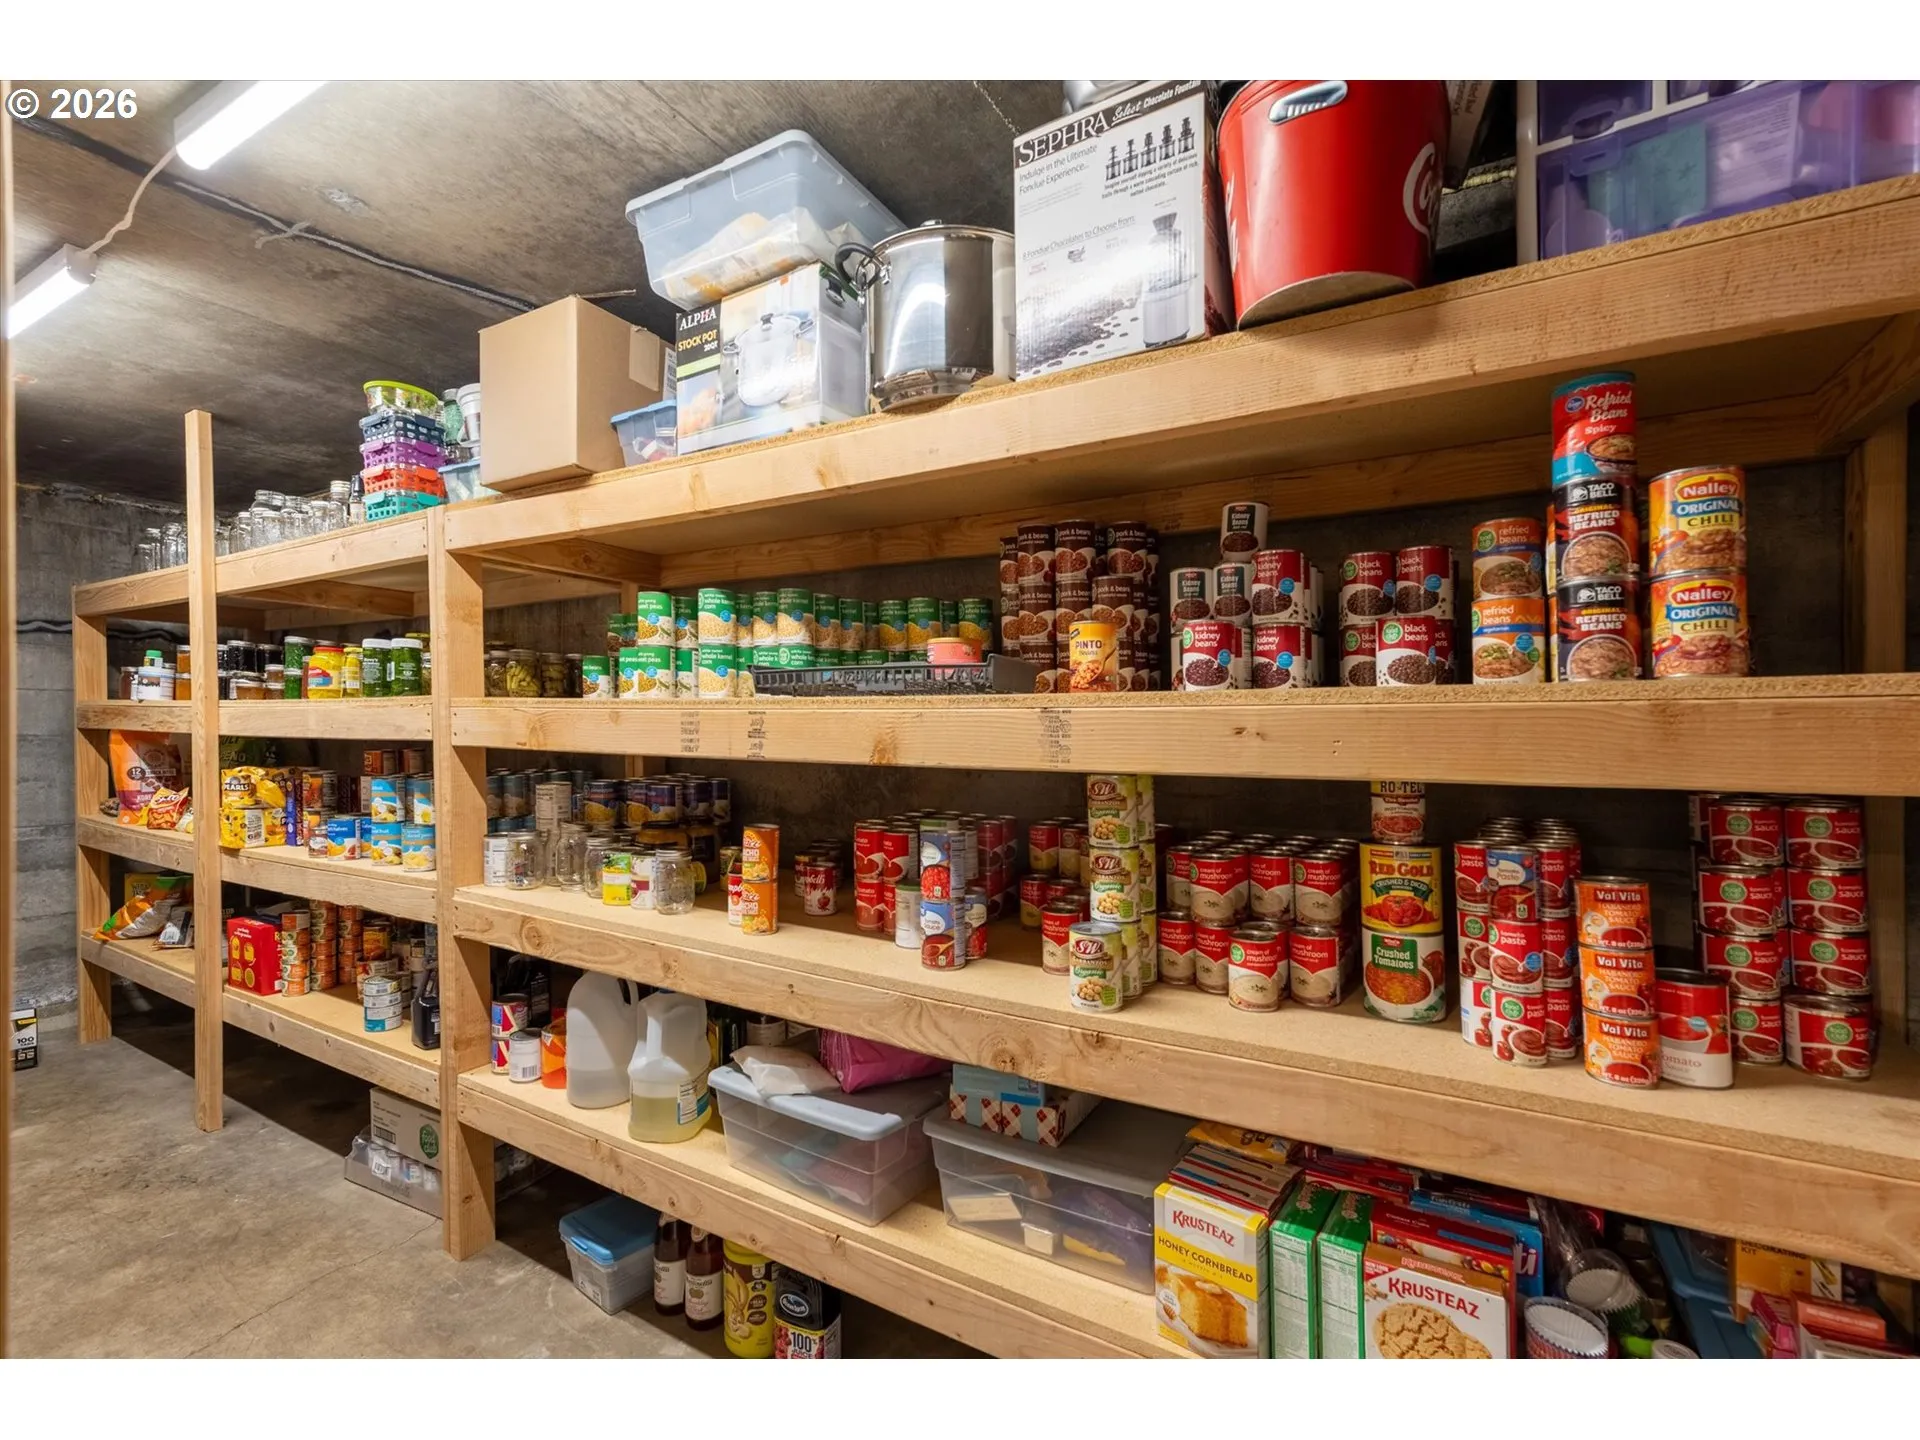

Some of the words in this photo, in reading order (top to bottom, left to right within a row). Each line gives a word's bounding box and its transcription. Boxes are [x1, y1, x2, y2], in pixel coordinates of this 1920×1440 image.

[1019, 111, 1110, 166] SEPHRA
[1112, 102, 1143, 122] Select
[1143, 89, 1174, 109] Chocolate
[1174, 80, 1201, 95] Fountain
[1019, 166, 1046, 182] Indulge
[1046, 165, 1053, 173] in
[1053, 158, 1066, 170] the
[1066, 145, 1098, 164] Ultimate
[1018, 180, 1045, 195] Fondue
[1092, 222, 1118, 234] Choose
[679, 307, 717, 331] ALPHA
[678, 334, 702, 352] STOCK
[702, 328, 717, 343] POT
[1585, 391, 1632, 410] Refried
[1591, 407, 1628, 423] Beans
[1585, 424, 1617, 434] Spicy
[1588, 482, 1615, 492] TACO
[1682, 482, 1737, 498] Nalley
[1588, 490, 1616, 499] BELL
[1676, 499, 1739, 515] ORIGINAL
[1231, 513, 1251, 521] Kidney
[1568, 510, 1620, 524] REFRIED
[1687, 514, 1735, 527] CHILI
[1575, 518, 1616, 530] BEANS
[1075, 528, 1092, 536] beans
[1499, 525, 1530, 535] refried
[1500, 535, 1528, 545] beans
[1360, 560, 1382, 569] black
[1360, 568, 1383, 577] beans
[1220, 576, 1239, 584] Kidney
[1114, 584, 1131, 593] beans
[1183, 585, 1200, 593] Beans
[1221, 582, 1238, 590] Beans
[1595, 586, 1622, 594] TACO
[1597, 592, 1624, 601] BELL
[1675, 587, 1731, 602] Nalley
[1483, 605, 1514, 615] refried
[1671, 605, 1736, 620] ORIGINAL
[1483, 615, 1512, 625] beans
[1576, 613, 1627, 624] REFRIED
[1404, 624, 1428, 633] black
[1580, 622, 1623, 631] BEANS
[1681, 621, 1729, 632] CHILI
[1194, 631, 1220, 641] kidney
[1256, 635, 1280, 645] kidney
[1404, 632, 1429, 642] beans
[1076, 640, 1103, 649] PINTO
[1194, 639, 1218, 648] beans
[1257, 642, 1277, 651] beans
[1362, 641, 1376, 649] bea
[131, 768, 142, 776] 12
[224, 783, 249, 791] PEARLS
[1369, 860, 1396, 877] RED
[1397, 862, 1434, 877] GOLD
[1461, 860, 1485, 868] paste
[1541, 864, 1565, 872] paste
[1497, 871, 1520, 881] Paste
[1094, 881, 1122, 892] Organic
[1375, 878, 1403, 888] CRUSHED
[1411, 879, 1428, 891] DICED
[1597, 891, 1617, 901] Val
[1619, 892, 1642, 901] Vita
[1500, 936, 1528, 946] paste
[1376, 946, 1411, 960] Crushed
[1373, 954, 1415, 970] Tomatoes
[1598, 956, 1617, 966] Val
[1620, 958, 1644, 968] Vita
[1073, 966, 1104, 979] Organic
[1547, 1004, 1570, 1012] paste
[1601, 1022, 1621, 1034] Val
[1624, 1025, 1648, 1037] Vita
[1661, 1054, 1702, 1068] omato
[1172, 1210, 1236, 1248] KRUSTEAZ
[1741, 1246, 1757, 1255] KIT
[1158, 1236, 1190, 1257] HONEY
[1191, 1252, 1254, 1284] CORNBREAD
[1388, 1277, 1482, 1320] KRUSTEAZ
